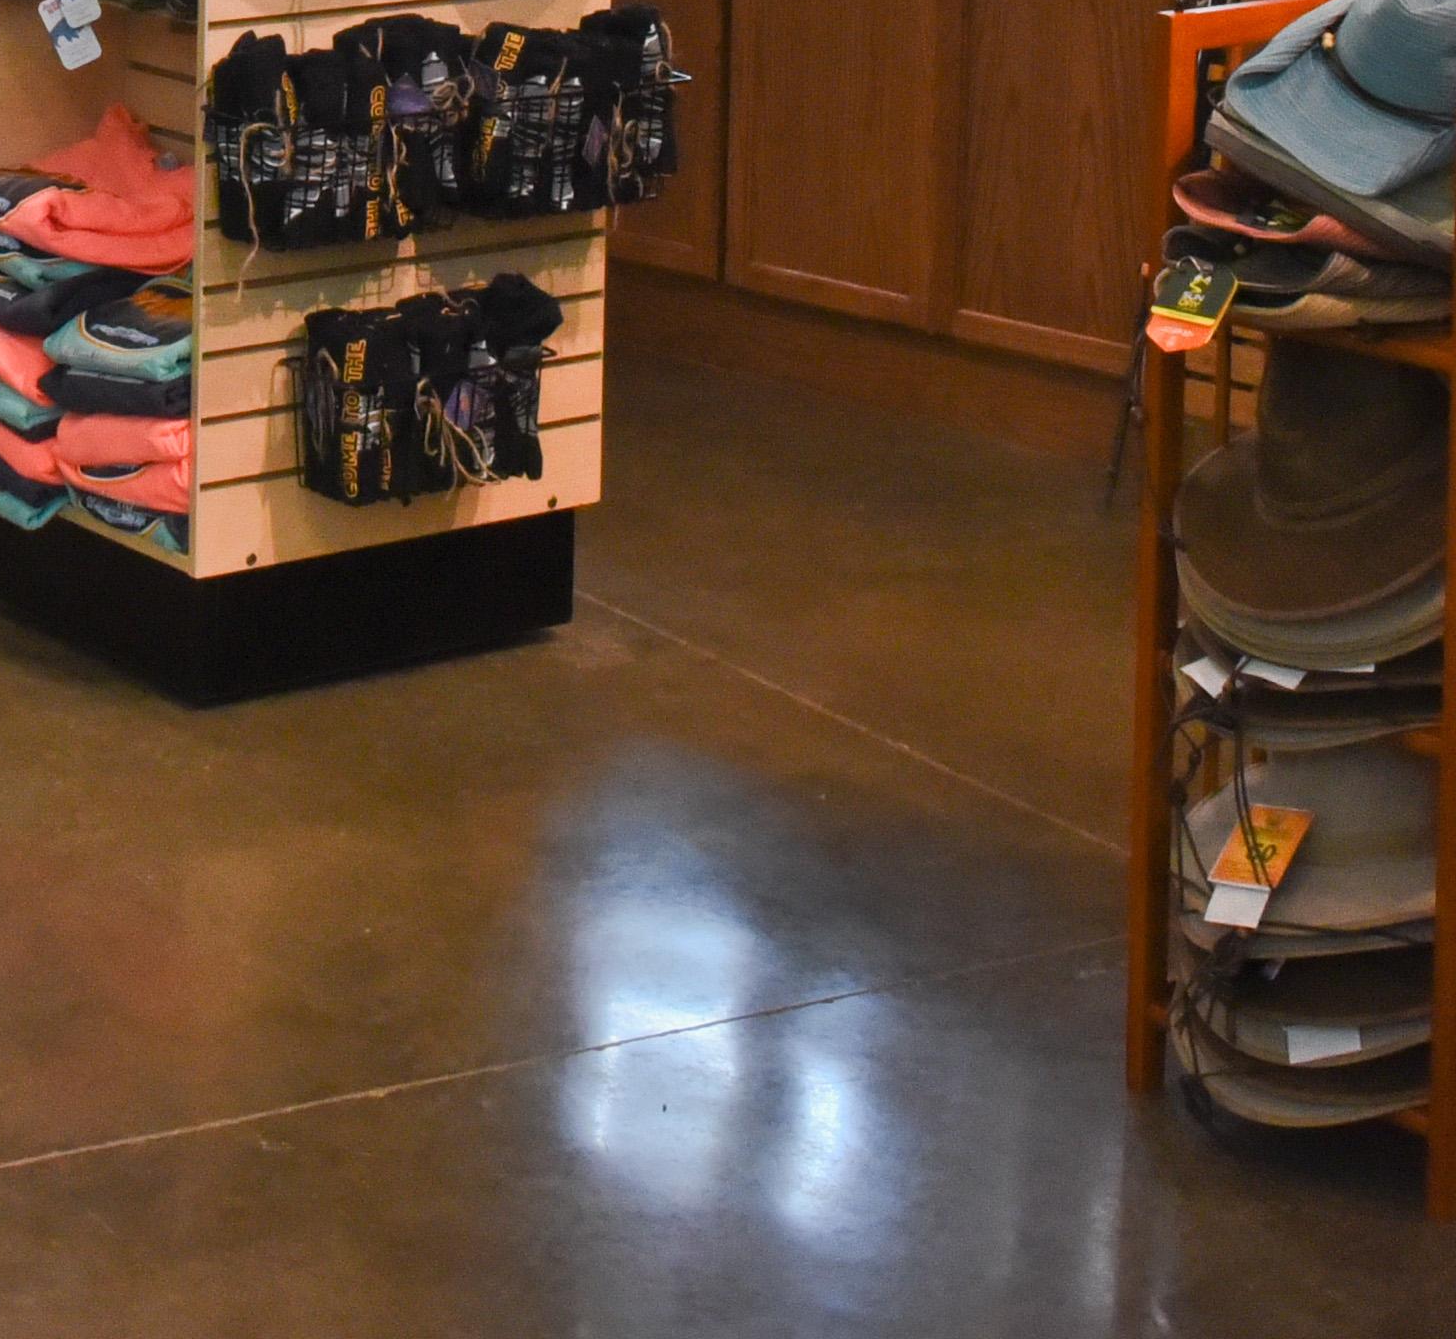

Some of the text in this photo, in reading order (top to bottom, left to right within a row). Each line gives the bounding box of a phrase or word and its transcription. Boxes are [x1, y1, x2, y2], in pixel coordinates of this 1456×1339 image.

[494, 31, 525, 71] THE
[342, 339, 367, 498] COME TO THE
